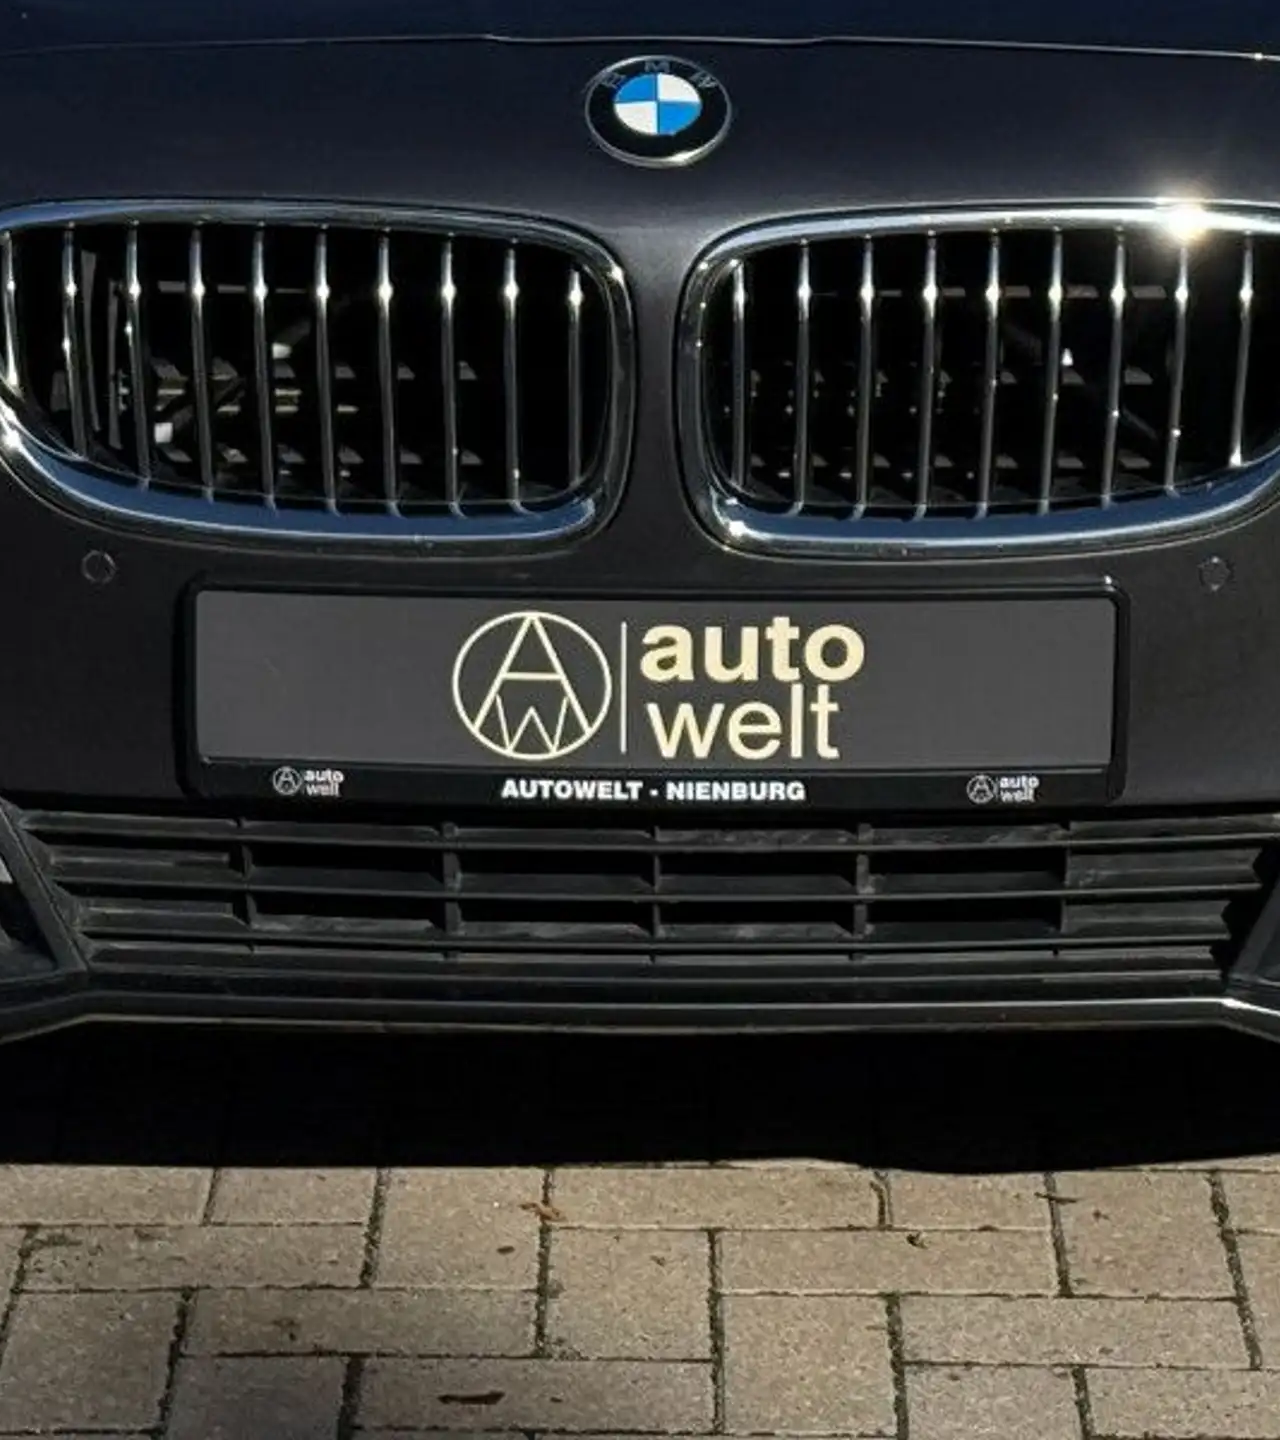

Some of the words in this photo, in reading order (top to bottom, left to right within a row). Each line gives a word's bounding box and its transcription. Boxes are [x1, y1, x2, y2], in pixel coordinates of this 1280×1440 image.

[639, 616, 866, 682] auto
[645, 683, 841, 760] welt
[304, 768, 344, 783] auto
[1000, 775, 1039, 790] auto
[306, 781, 339, 797] welt
[501, 779, 644, 801] AUTOWELT
[665, 781, 806, 801] NIENBURG
[1001, 787, 1035, 802] welt
